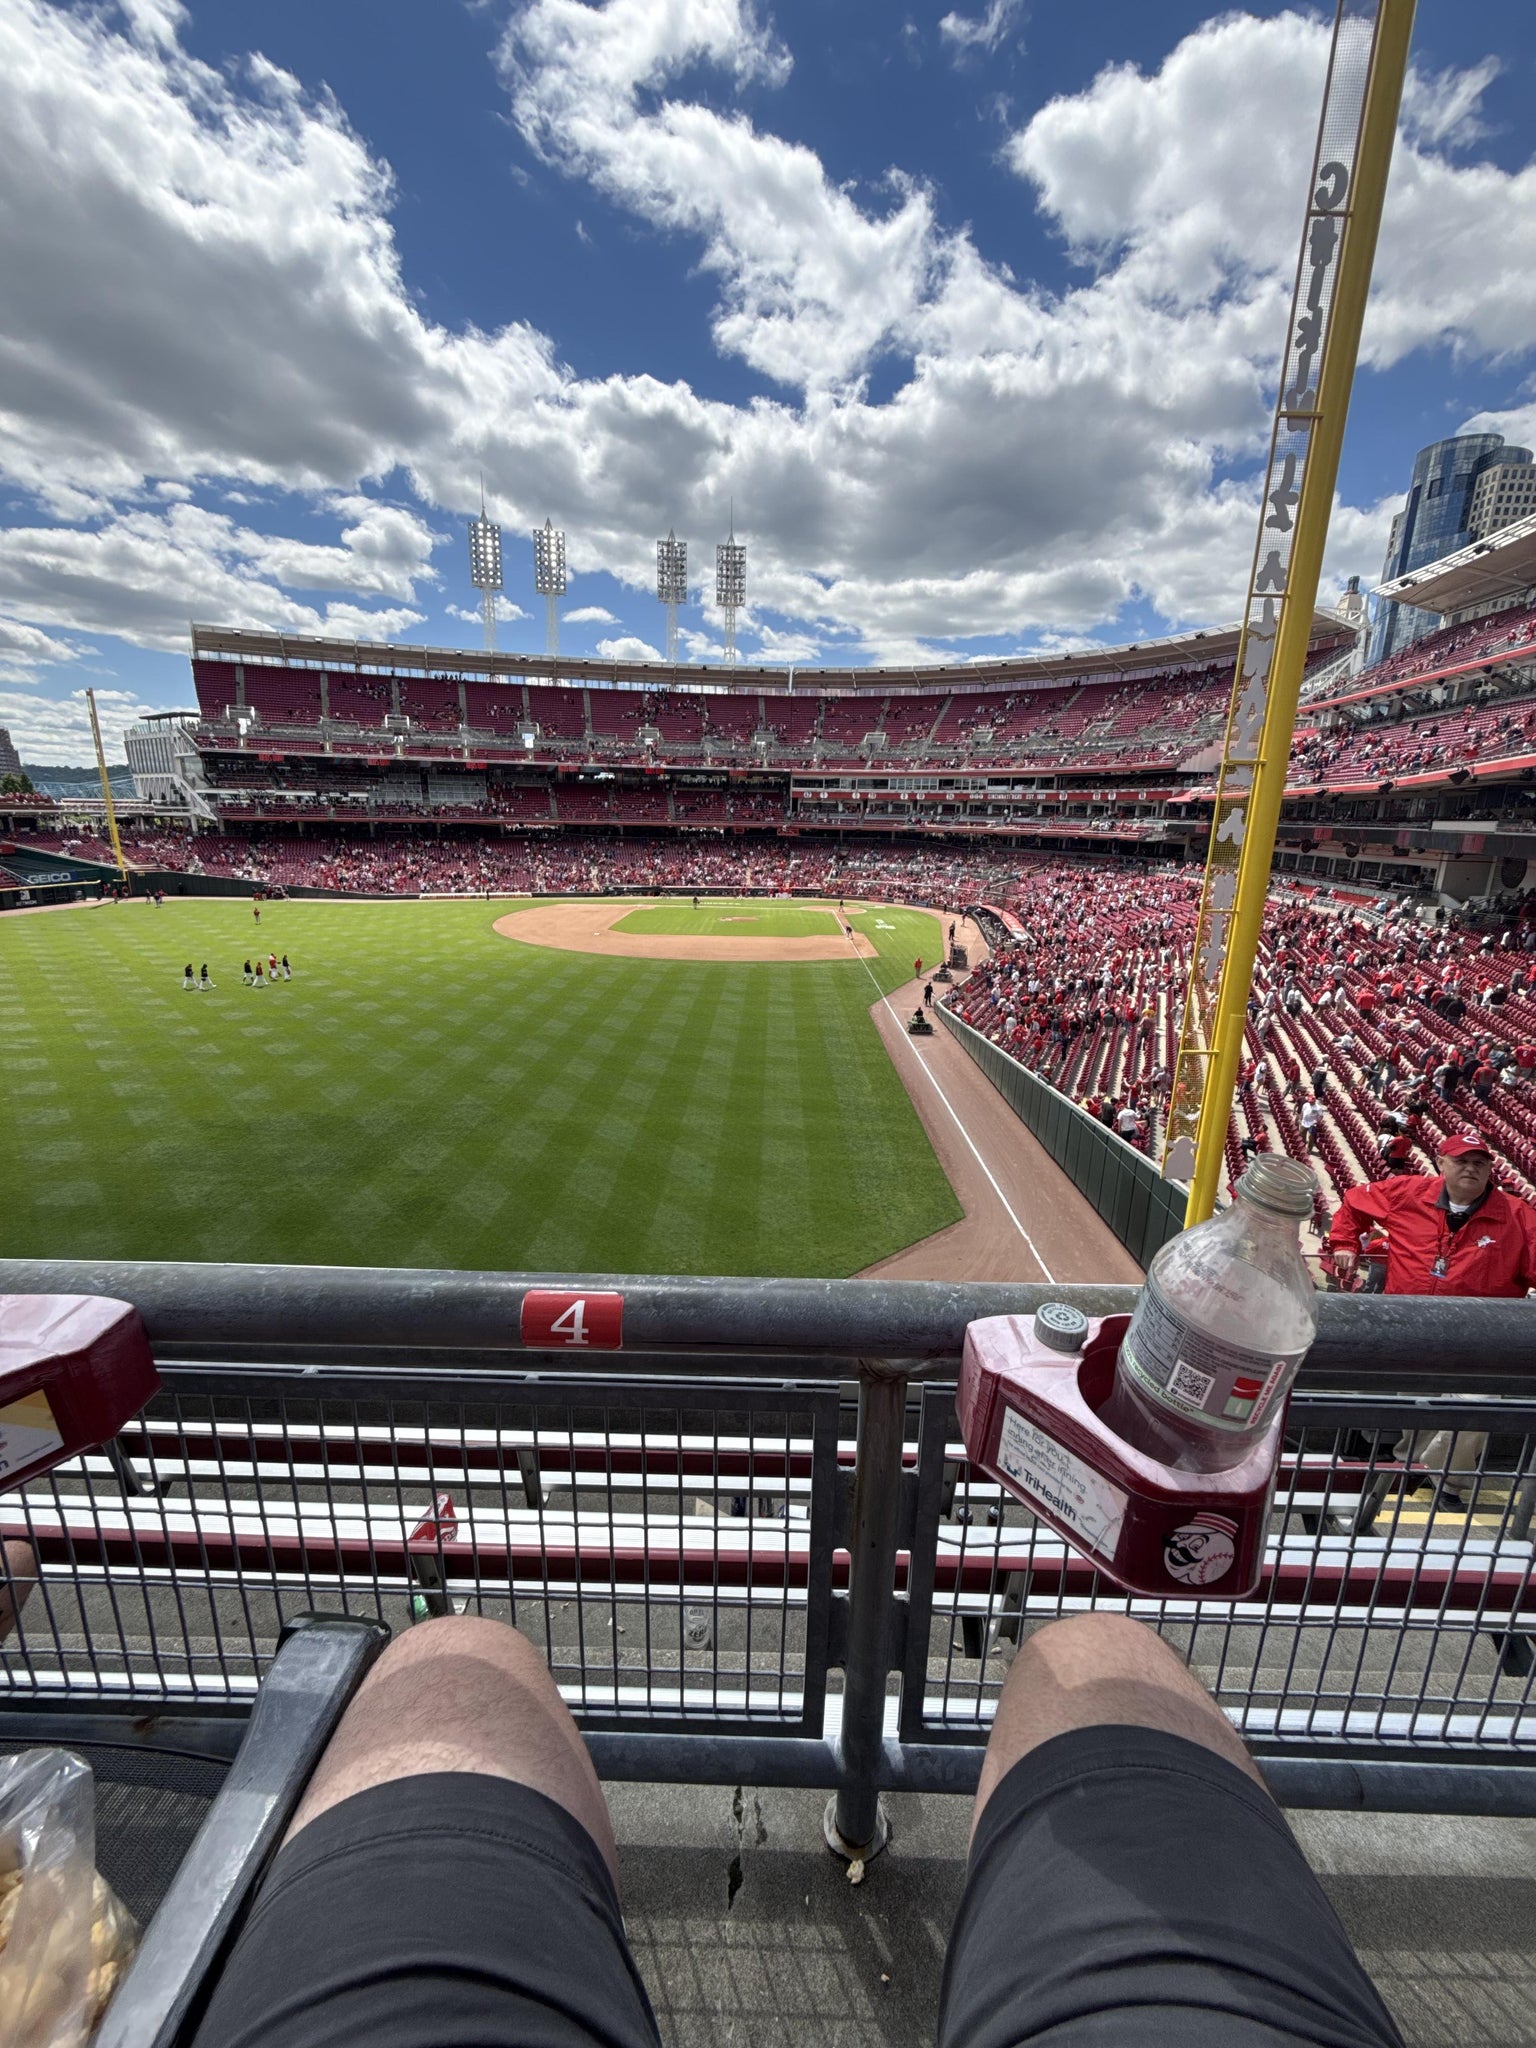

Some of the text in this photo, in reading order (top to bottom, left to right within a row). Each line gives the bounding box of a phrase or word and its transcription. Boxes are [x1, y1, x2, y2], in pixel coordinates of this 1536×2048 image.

[28, 872, 71, 884] GEICO
[550, 1299, 589, 1344] 4
[1132, 1361, 1160, 1392] recycled
[1249, 1362, 1284, 1426] RECYCLE ME AGAIN
[1007, 1428, 1034, 1454] inning
[1008, 1416, 1030, 1437] Here
[1032, 1428, 1045, 1447] for
[1023, 1468, 1078, 1522] TriHealth
